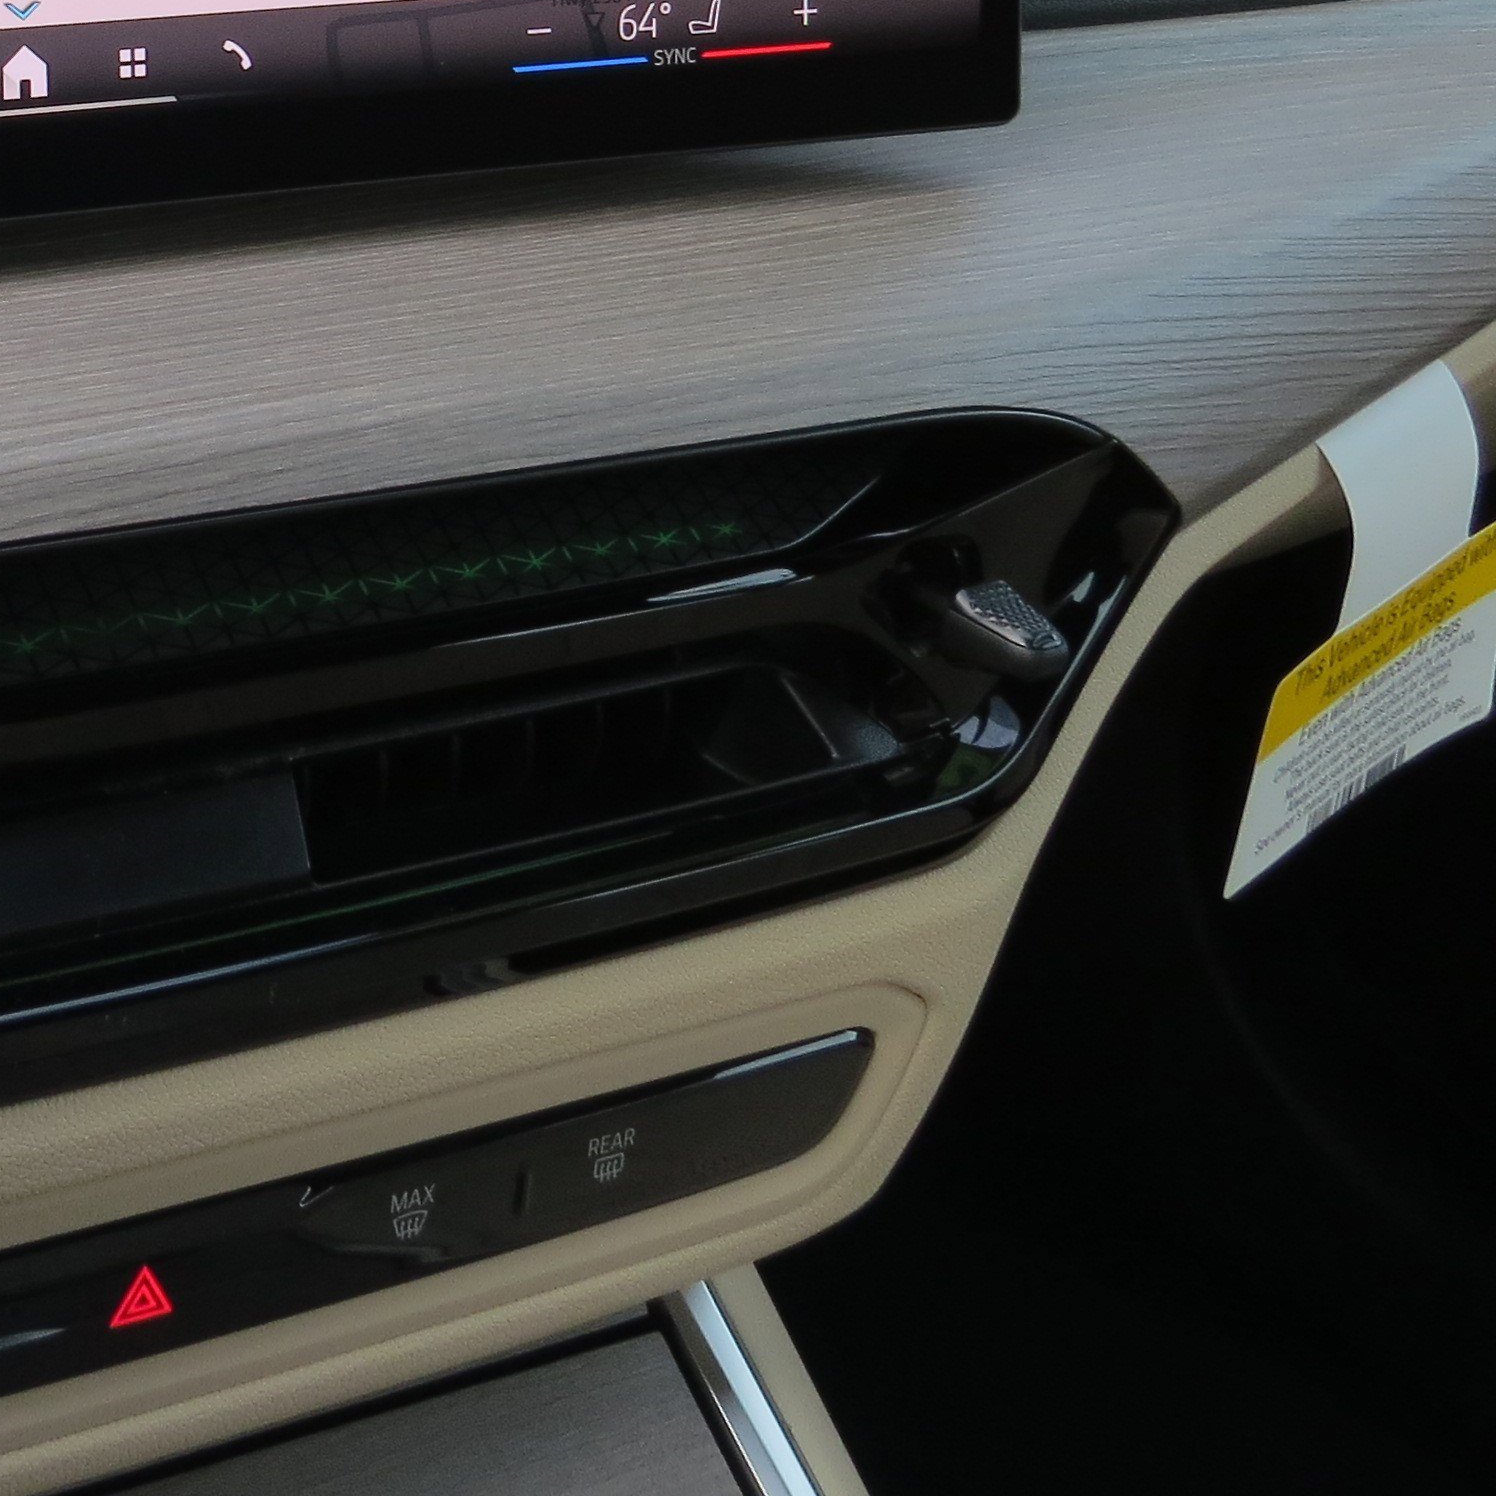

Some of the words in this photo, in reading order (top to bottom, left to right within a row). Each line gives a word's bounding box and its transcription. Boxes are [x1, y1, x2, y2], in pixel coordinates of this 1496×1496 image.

[618, 2, 673, 41] 64°
[654, 47, 697, 66] SYNC
[1328, 615, 1385, 667] Vehicle
[588, 1127, 636, 1156] REAR
[390, 1183, 436, 1213] MAX
